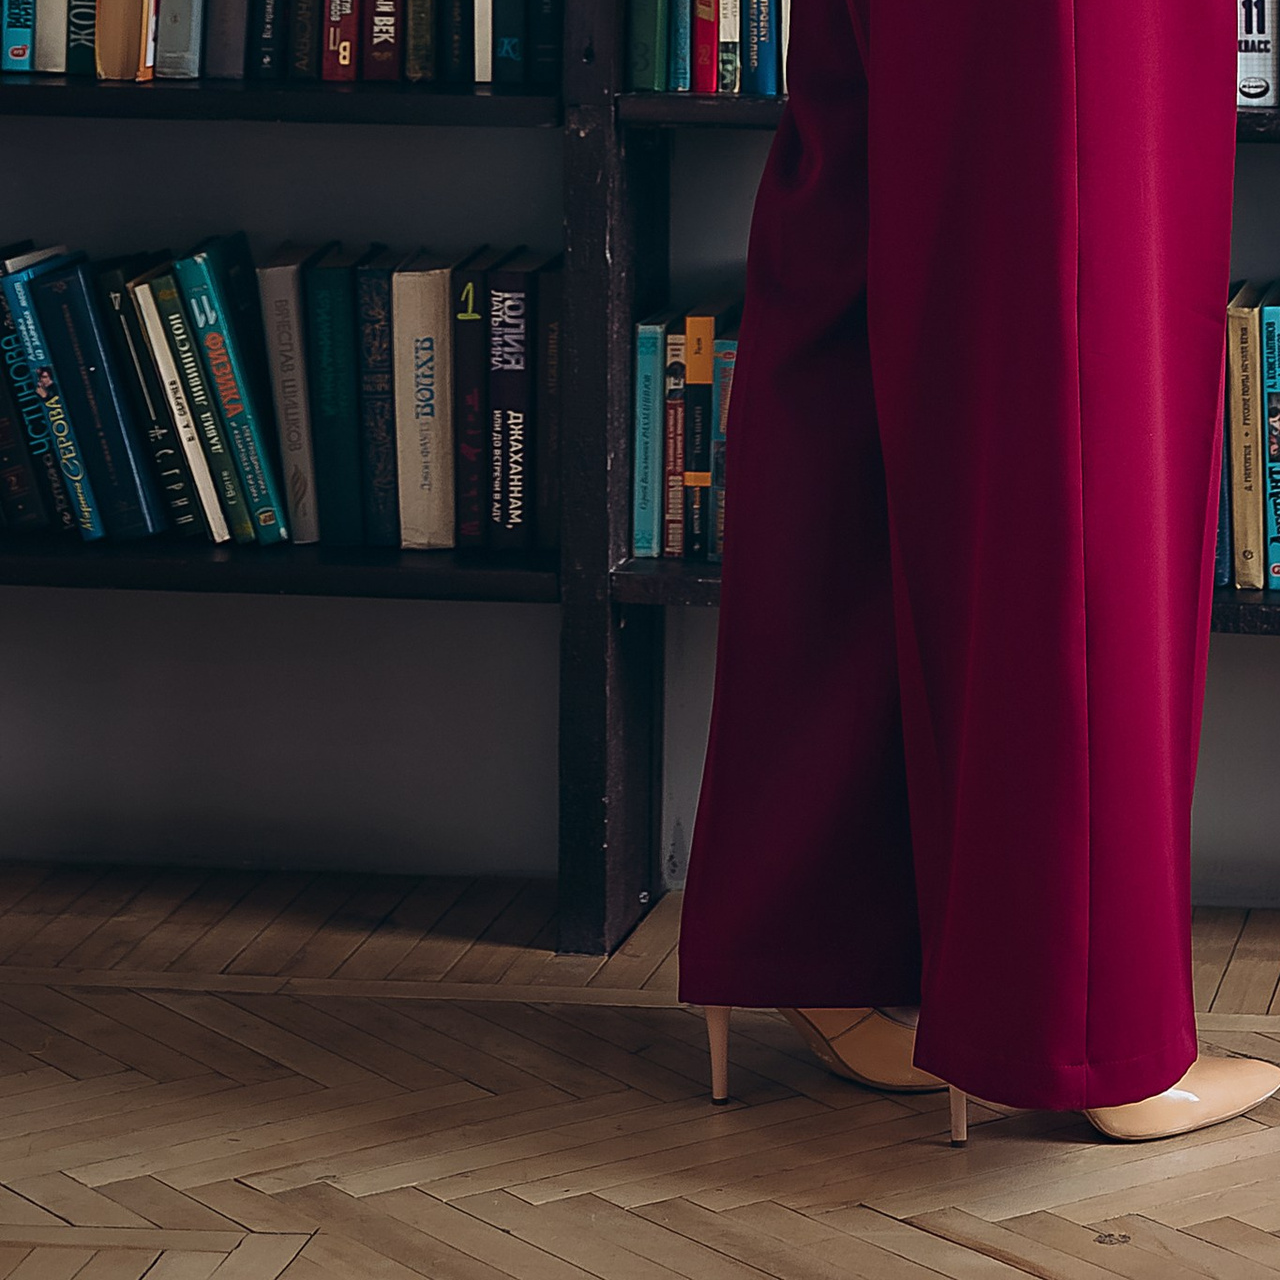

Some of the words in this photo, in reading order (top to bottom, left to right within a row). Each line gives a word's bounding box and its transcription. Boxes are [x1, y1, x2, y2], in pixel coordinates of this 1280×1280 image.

[373, 15, 396, 45] ВЕК
[501, 291, 526, 372] ЮЛИЯ
[203, 331, 245, 419] ФИЗИКА
[42, 394, 82, 482] СЕРОВА
[199, 411, 224, 455] ДАВИД
[72, 481, 95, 531] Марина
